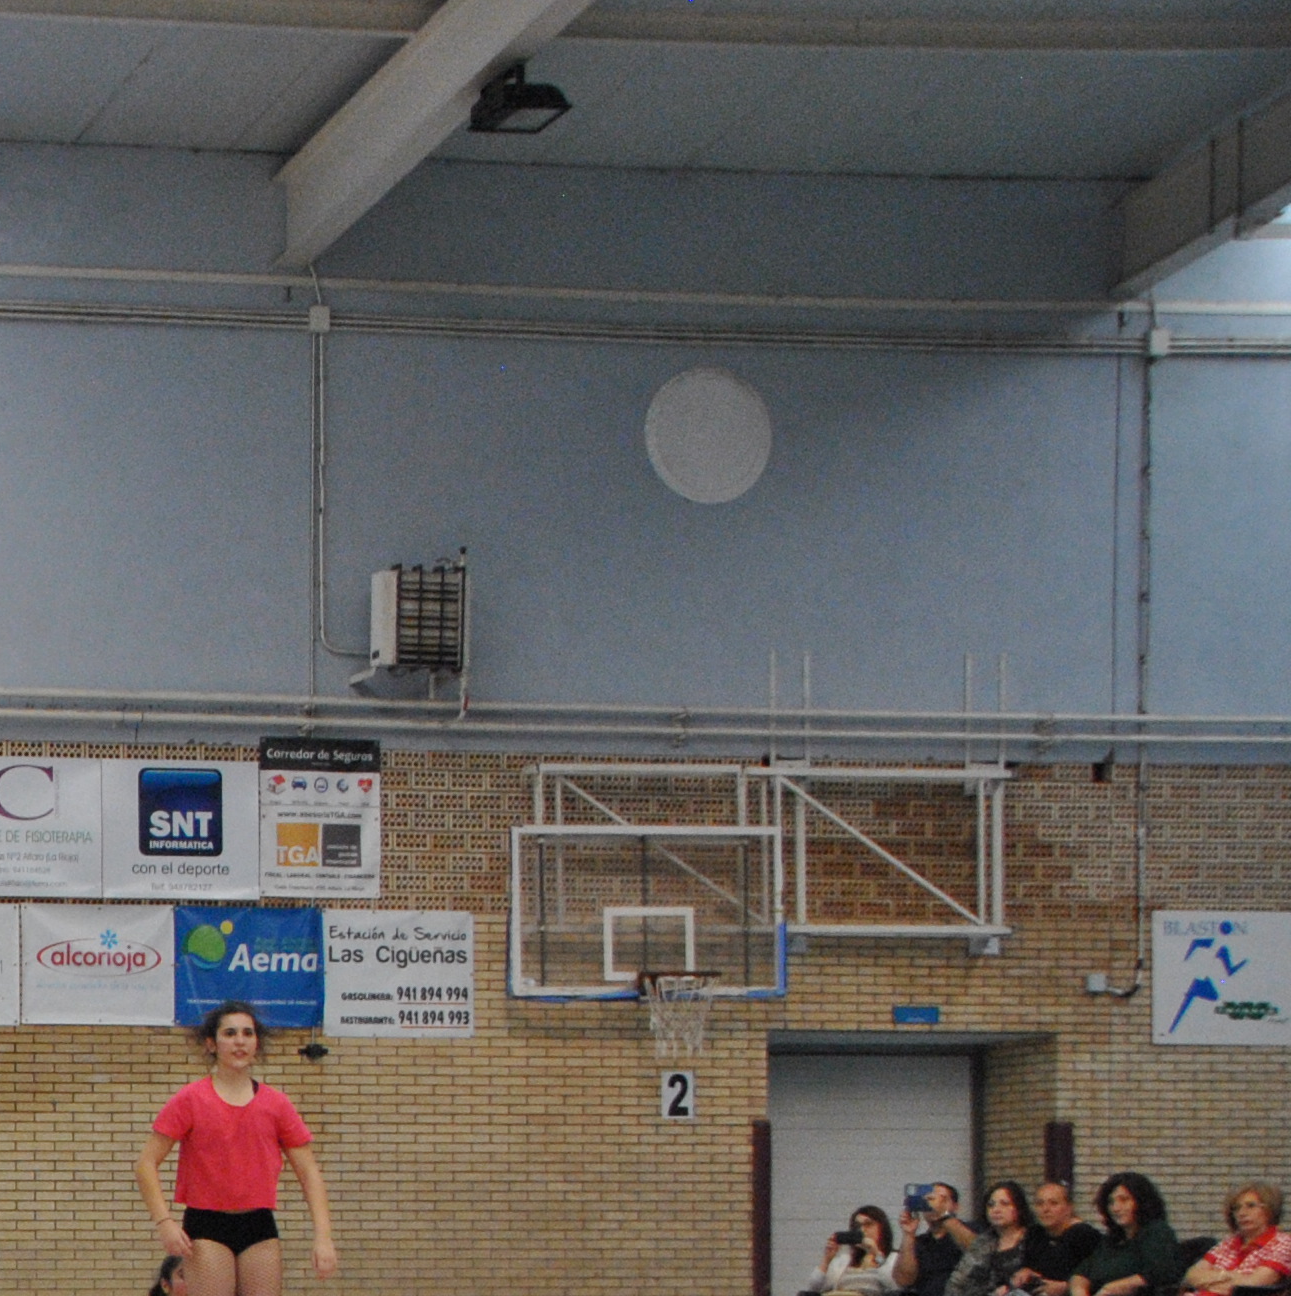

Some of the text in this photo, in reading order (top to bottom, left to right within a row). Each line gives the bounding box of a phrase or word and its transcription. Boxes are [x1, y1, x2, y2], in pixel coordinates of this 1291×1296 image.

[266, 748, 373, 763] Corredor de Seguros
[149, 810, 213, 838] SNT
[6, 830, 20, 843] DE
[25, 830, 93, 844] FISIOTERAPIA
[149, 840, 214, 850] INFORMATICA
[277, 846, 319, 864] TGA
[132, 862, 230, 877] con el deporte
[329, 925, 467, 942] Estación de Servicio
[227, 943, 318, 972] Aema
[328, 946, 467, 969] Las Cigüeñas
[397, 986, 417, 1001] 941
[420, 986, 442, 1001] 894
[446, 986, 468, 1001] 994
[398, 1010, 419, 1025] 941
[422, 1010, 444, 1025] 894
[448, 1010, 470, 1025] 993
[668, 1074, 689, 1117] 2
